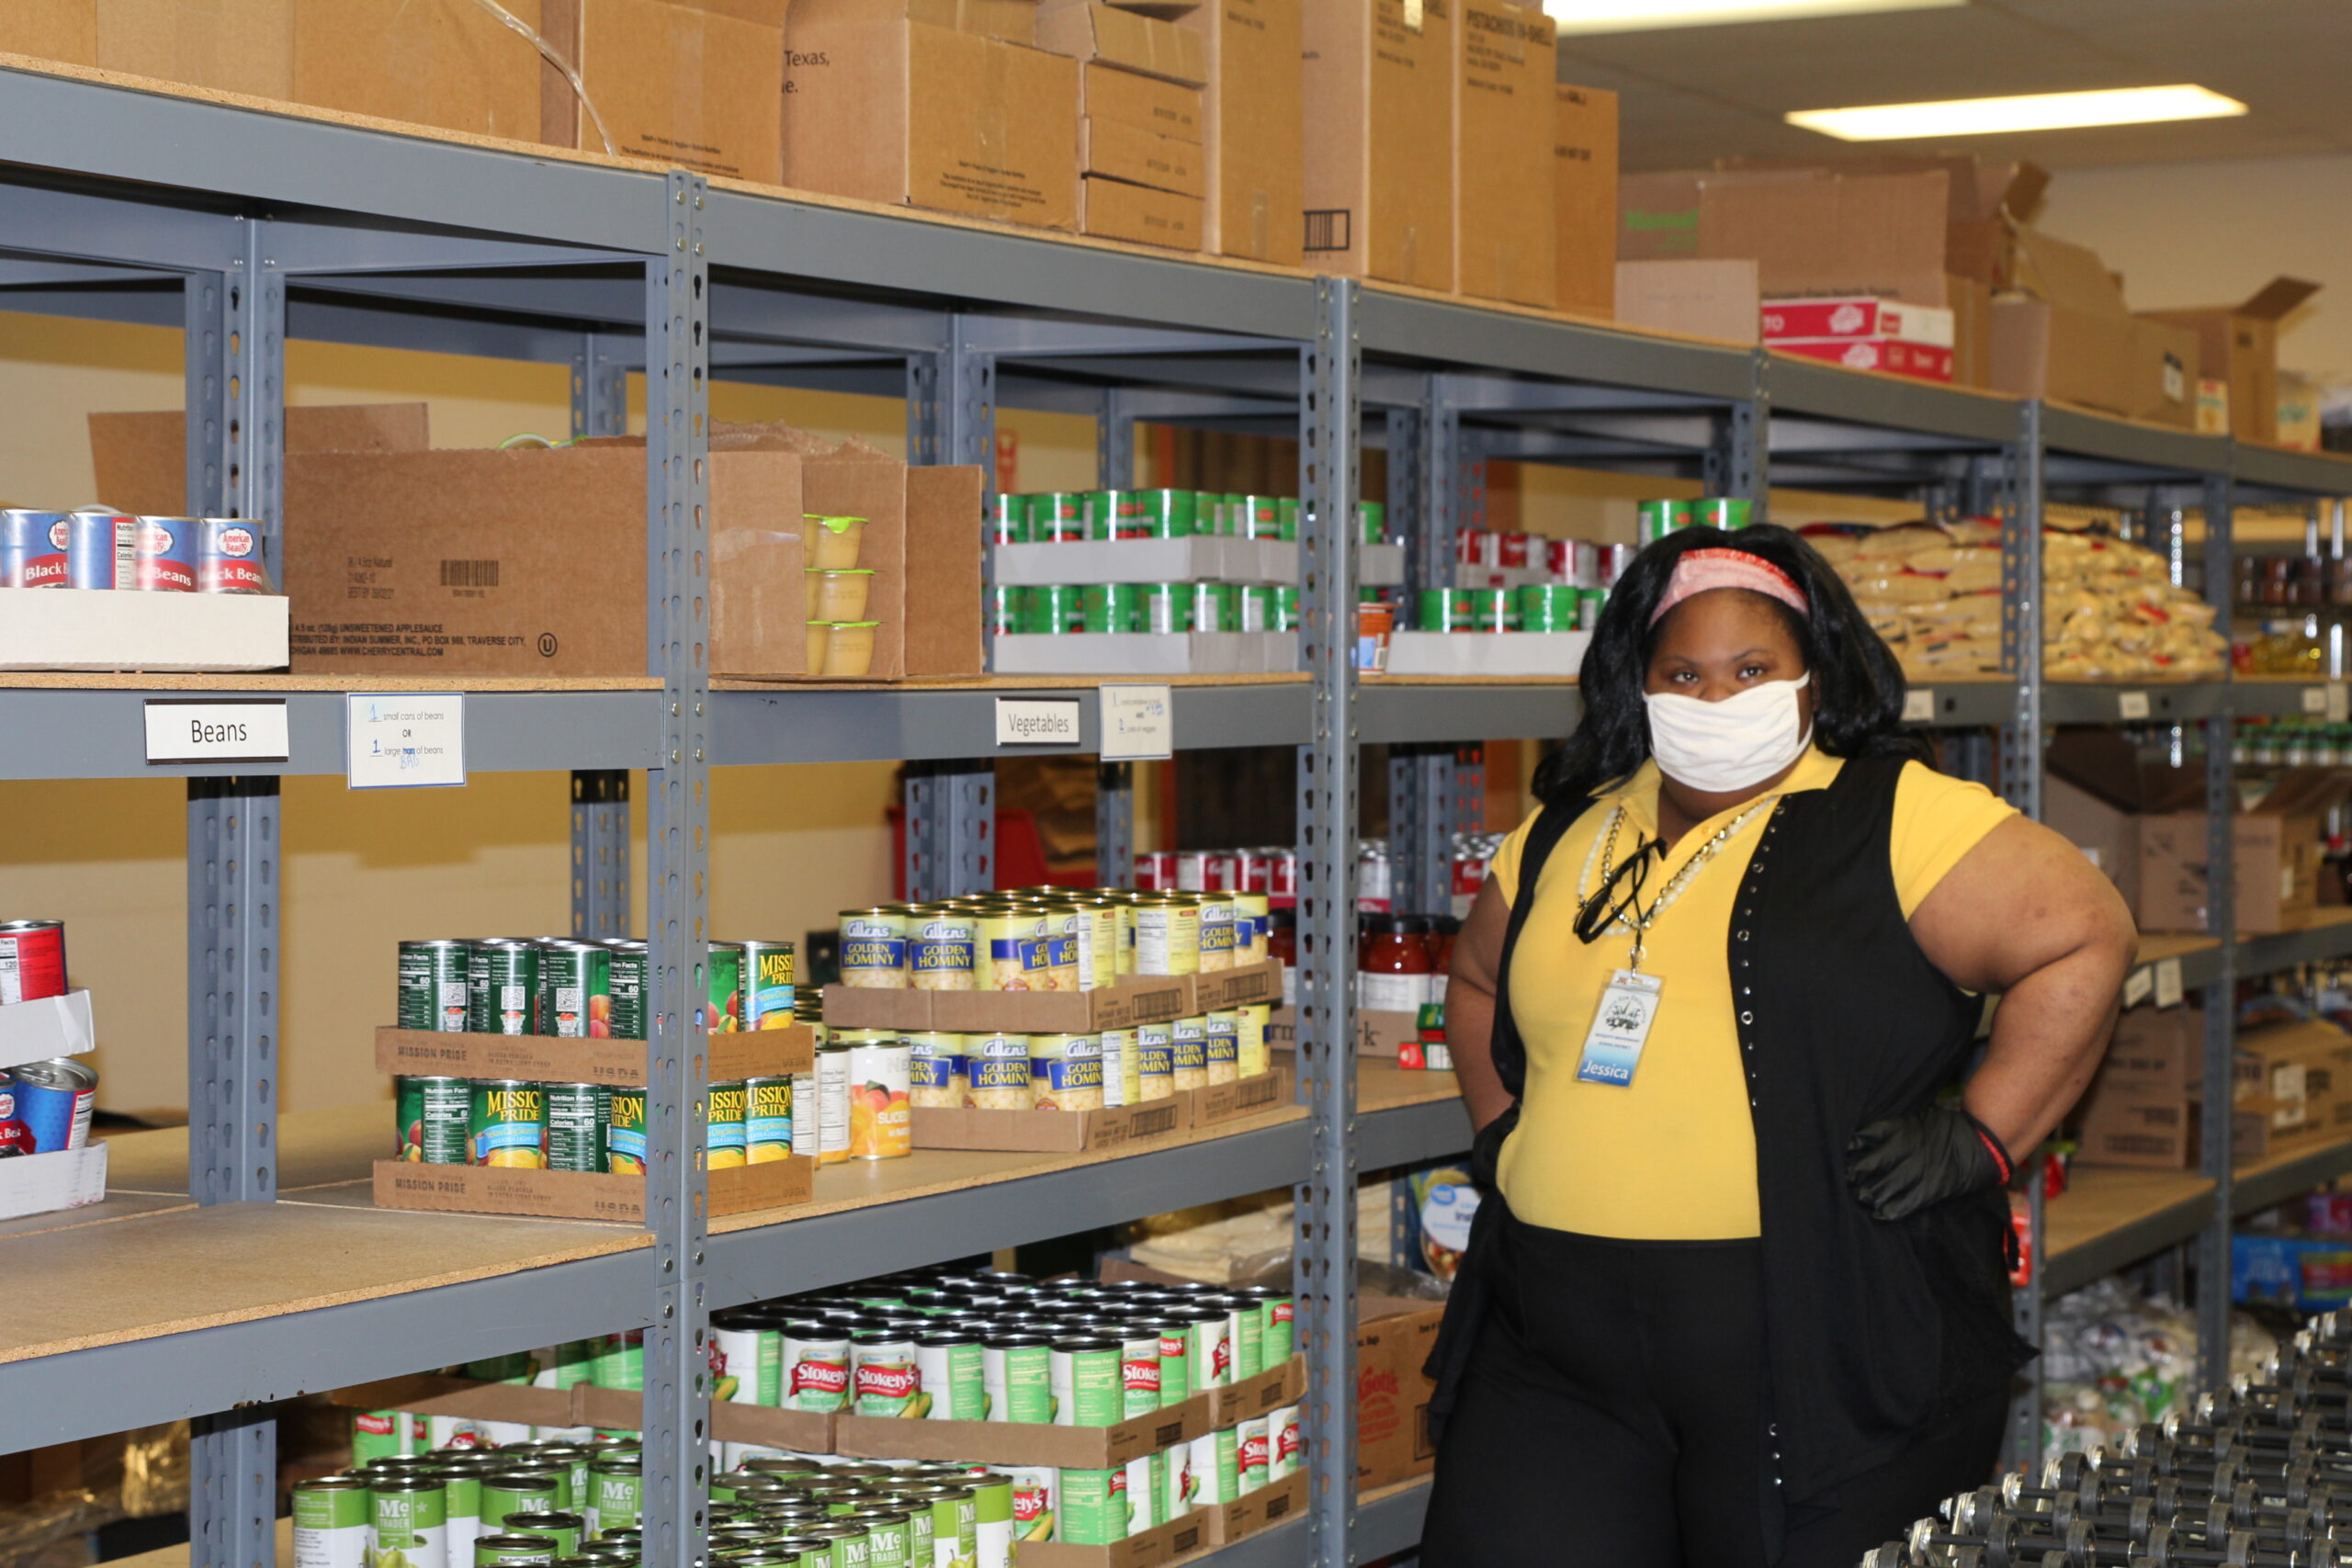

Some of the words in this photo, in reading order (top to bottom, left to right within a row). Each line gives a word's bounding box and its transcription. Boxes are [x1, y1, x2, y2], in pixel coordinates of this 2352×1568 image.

[784, 50, 830, 66] Texas,
[223, 535, 250, 544] American
[25, 561, 62, 581] Black
[153, 566, 192, 588] Beans
[340, 625, 394, 633] UNSWEETENED
[396, 625, 444, 634] APPLESAUCE
[343, 635, 368, 644] INDIAN
[422, 636, 433, 645] PO
[435, 636, 449, 645] BOX
[467, 636, 506, 646] TRAVERSE
[508, 637, 526, 648] CITY,
[383, 711, 399, 721] small
[416, 711, 424, 720] of
[425, 711, 445, 721] beans
[191, 720, 247, 743] Beans
[1009, 714, 1069, 737] Vegetables
[402, 728, 412, 738] OR
[372, 739, 381, 753] 1
[385, 747, 401, 758] large
[416, 746, 424, 755] of
[424, 746, 444, 755] beans
[847, 920, 889, 938] Allens
[923, 921, 967, 940] Allens
[847, 943, 889, 953] GOLDEN
[923, 945, 967, 955] GOLDEN
[5, 961, 17, 969] 120
[845, 953, 896, 965] HOMINY
[919, 955, 971, 967] HOMINY
[420, 976, 430, 985] 60
[480, 979, 490, 987] 60
[628, 985, 639, 993] 60
[398, 1045, 437, 1060] MISSION
[440, 1047, 468, 1061] PRIDE
[983, 1039, 1027, 1057] Allens
[983, 1063, 1027, 1073] GOLDEN
[1583, 1060, 1629, 1080] Jessica
[500, 1109, 539, 1122] PRIDE
[707, 1109, 743, 1122] PRIDE
[751, 1103, 787, 1117] PRIDE
[583, 1117, 594, 1126] 60
[396, 1179, 435, 1191] MISSION
[438, 1180, 467, 1194] PRIDE
[603, 1499, 633, 1510] TRADER
[380, 1517, 409, 1529] TRADER
[873, 1550, 902, 1562] TRADER
